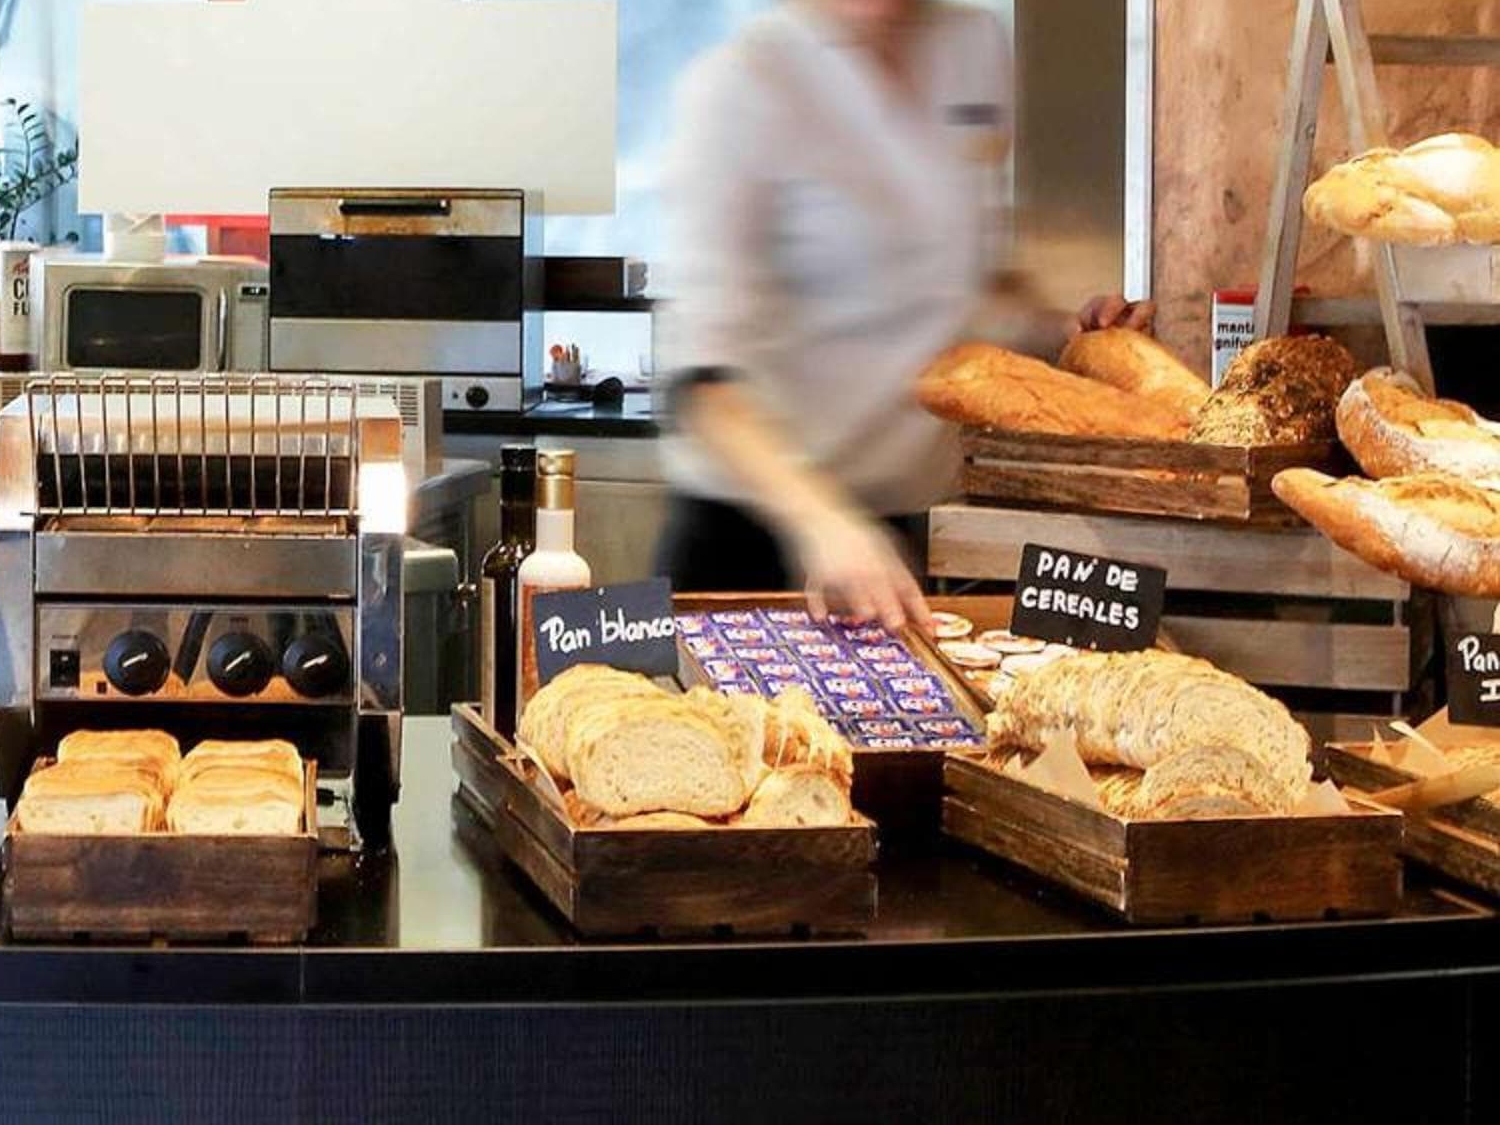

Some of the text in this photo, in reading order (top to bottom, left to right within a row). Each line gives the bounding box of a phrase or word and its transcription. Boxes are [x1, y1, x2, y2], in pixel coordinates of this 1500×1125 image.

[1036, 550, 1139, 592] PAN DE
[1021, 585, 1140, 630] CEREALES
[539, 608, 677, 654] Pan blanco
